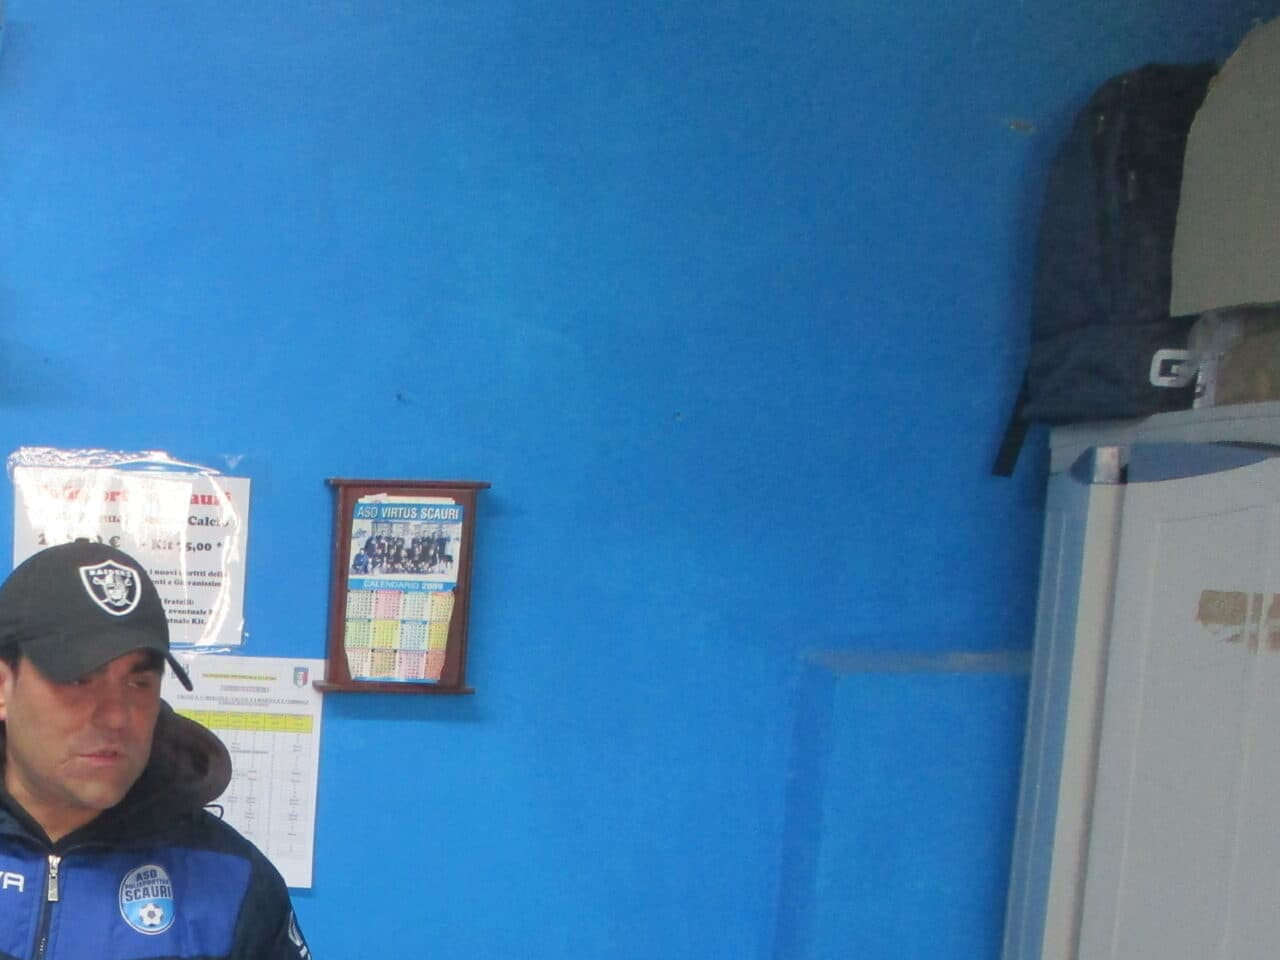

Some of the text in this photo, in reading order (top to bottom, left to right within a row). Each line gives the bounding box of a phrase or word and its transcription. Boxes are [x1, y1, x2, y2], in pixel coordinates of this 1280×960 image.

[357, 506, 459, 520] ASD VIRTUS SCAURI
[124, 886, 172, 902] SCAURI
